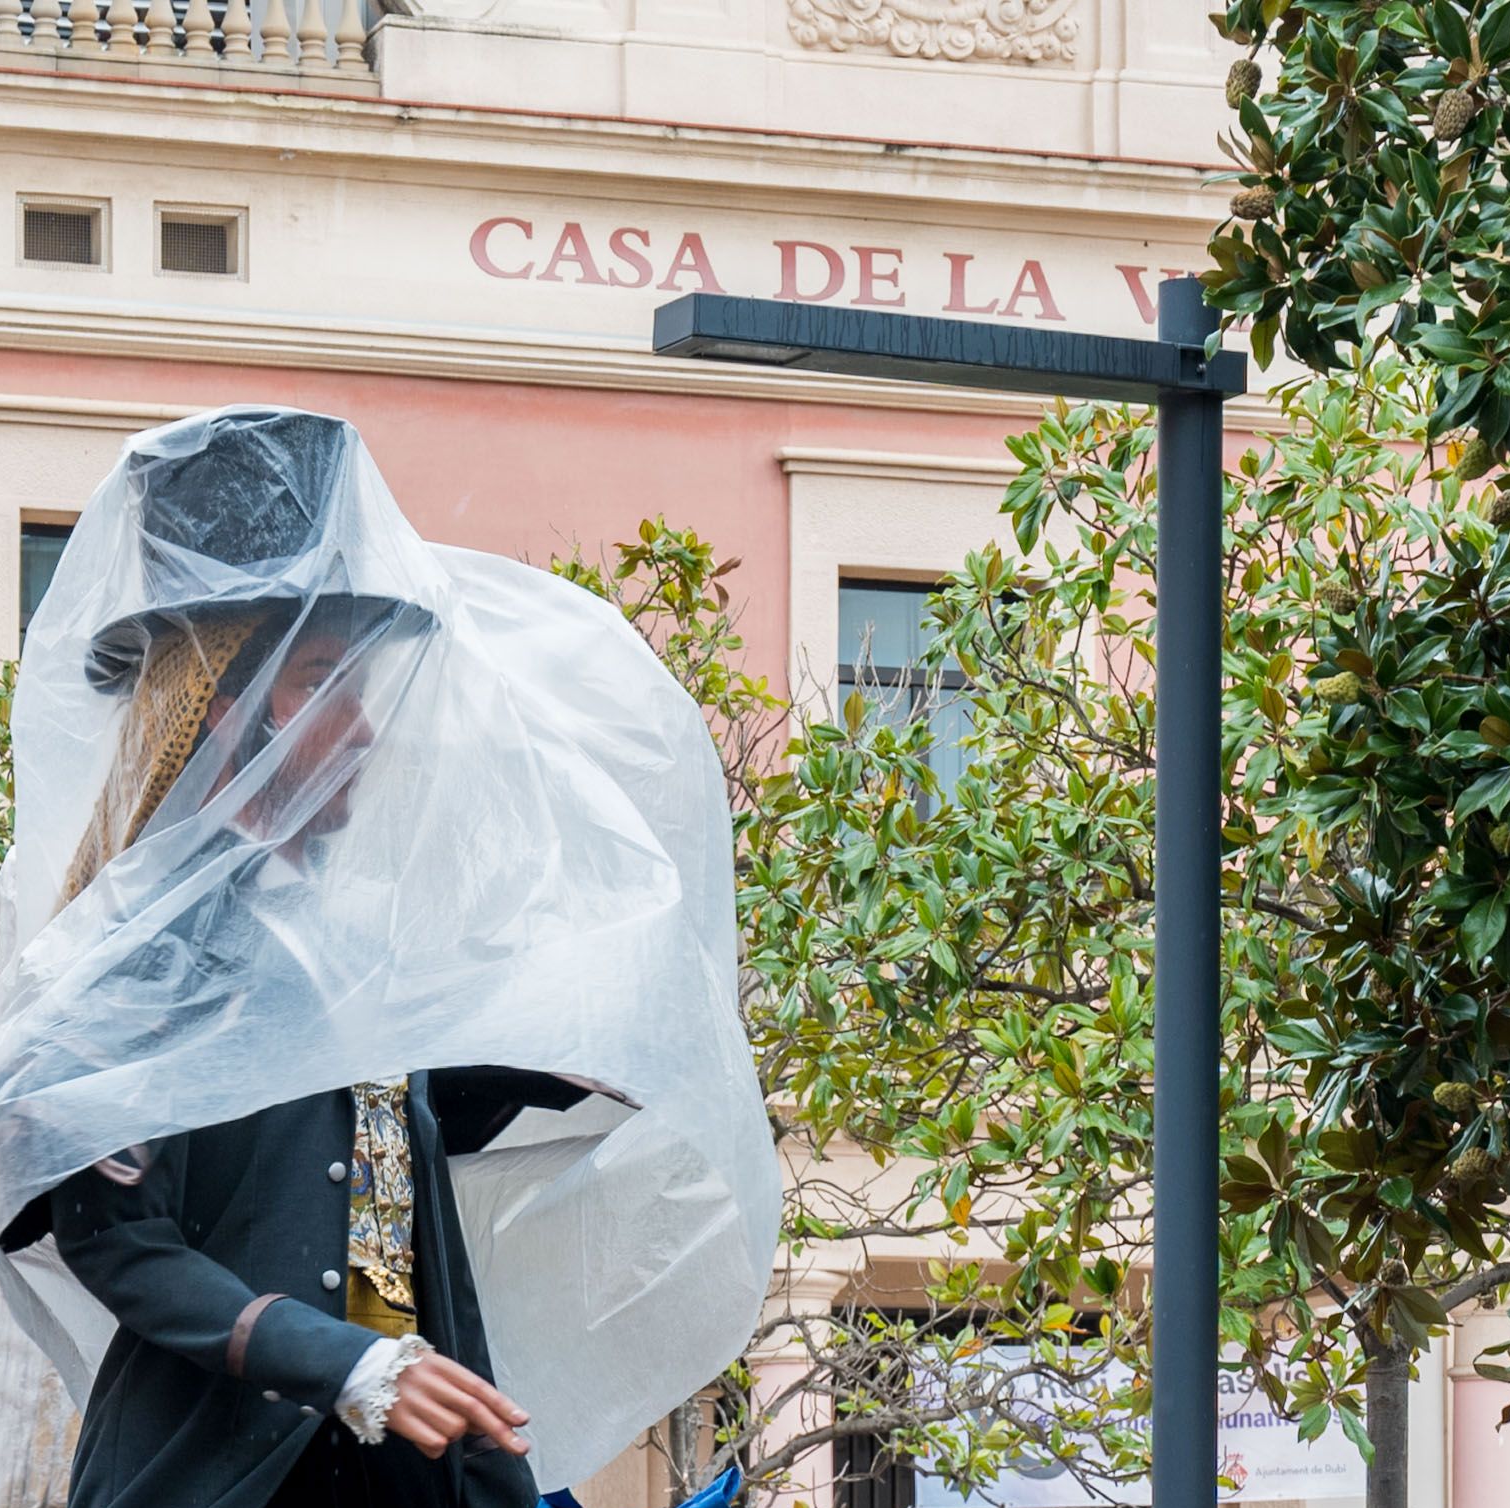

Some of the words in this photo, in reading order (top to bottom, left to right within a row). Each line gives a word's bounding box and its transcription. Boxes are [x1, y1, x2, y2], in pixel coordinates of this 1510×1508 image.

[468, 216, 728, 294] CASA
[772, 240, 906, 307] DE
[942, 252, 1067, 321] LA
[1254, 1465, 1310, 1479] Ajuntament
[1311, 1464, 1324, 1475] de
